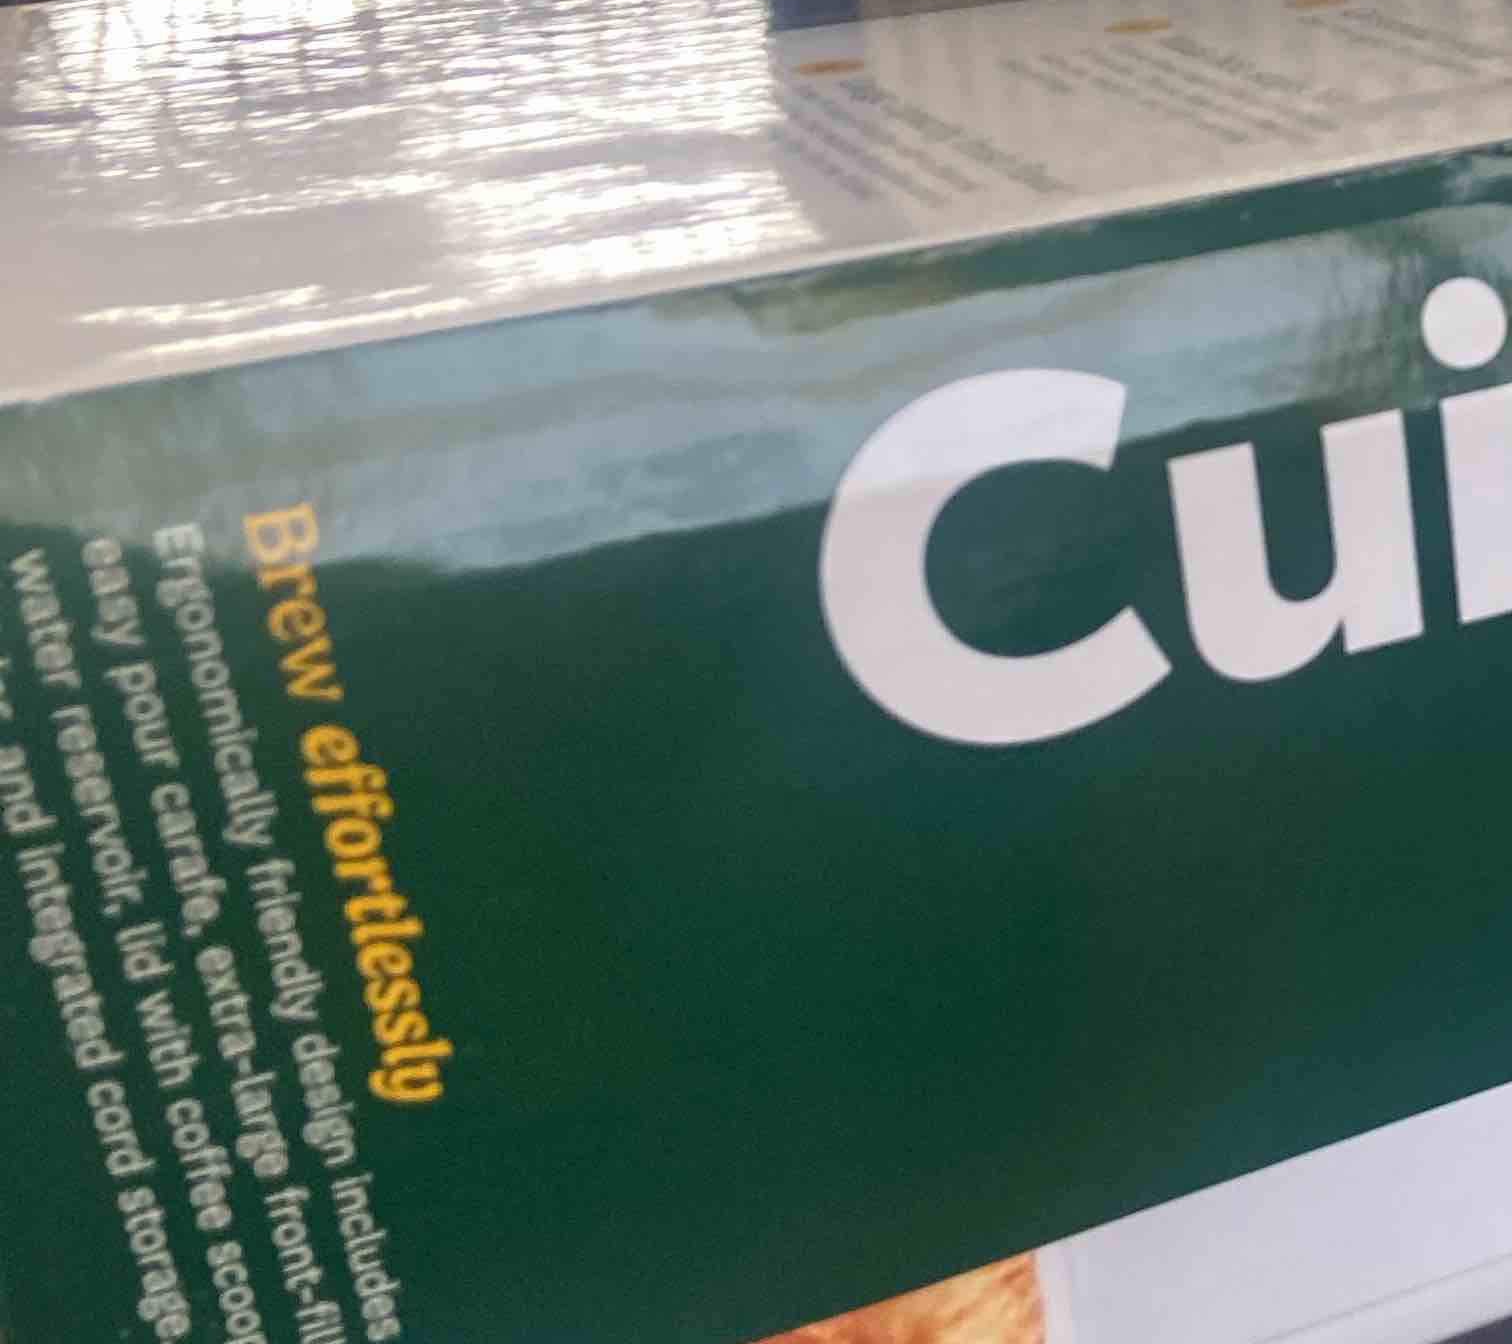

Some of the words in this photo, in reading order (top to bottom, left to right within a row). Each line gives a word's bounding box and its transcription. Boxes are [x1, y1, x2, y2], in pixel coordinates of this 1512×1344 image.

[11, 548, 82, 690] water
[81, 536, 146, 646] easy
[105, 661, 180, 769] pour
[0, 745, 57, 836] and
[242, 501, 345, 702] Brew
[301, 725, 453, 1103] effortlessly
[150, 782, 227, 939] carafe,
[17, 843, 125, 1070] integrated
[115, 920, 175, 983] lid
[153, 523, 279, 847] Ergonomically
[245, 857, 327, 1022] friendly
[292, 1033, 355, 1167] design
[331, 1172, 401, 1342] includes
[137, 990, 200, 1089] with
[196, 944, 289, 1178] extra-large
[87, 1079, 155, 1177] cord
[166, 1098, 232, 1231] coffee
